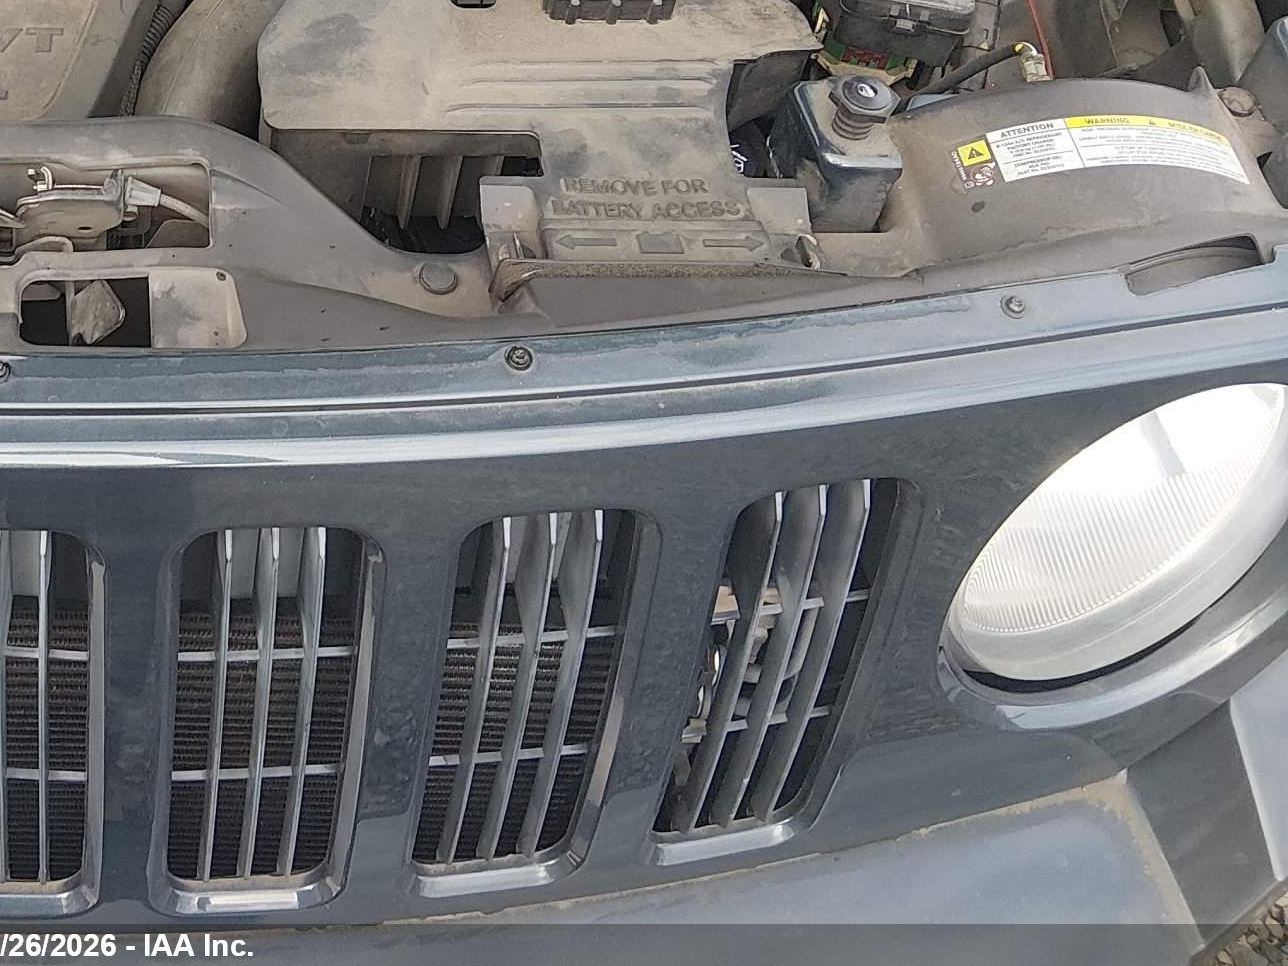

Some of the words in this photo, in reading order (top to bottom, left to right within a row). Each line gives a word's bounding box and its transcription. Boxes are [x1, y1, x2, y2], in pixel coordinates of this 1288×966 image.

[1084, 116, 1130, 125] WARNING
[1001, 122, 1055, 138] ATTENTION
[562, 177, 658, 196] REMOVE
[661, 177, 708, 196] FOR
[552, 199, 644, 219] BATTERY
[653, 199, 742, 219] ACCESS
